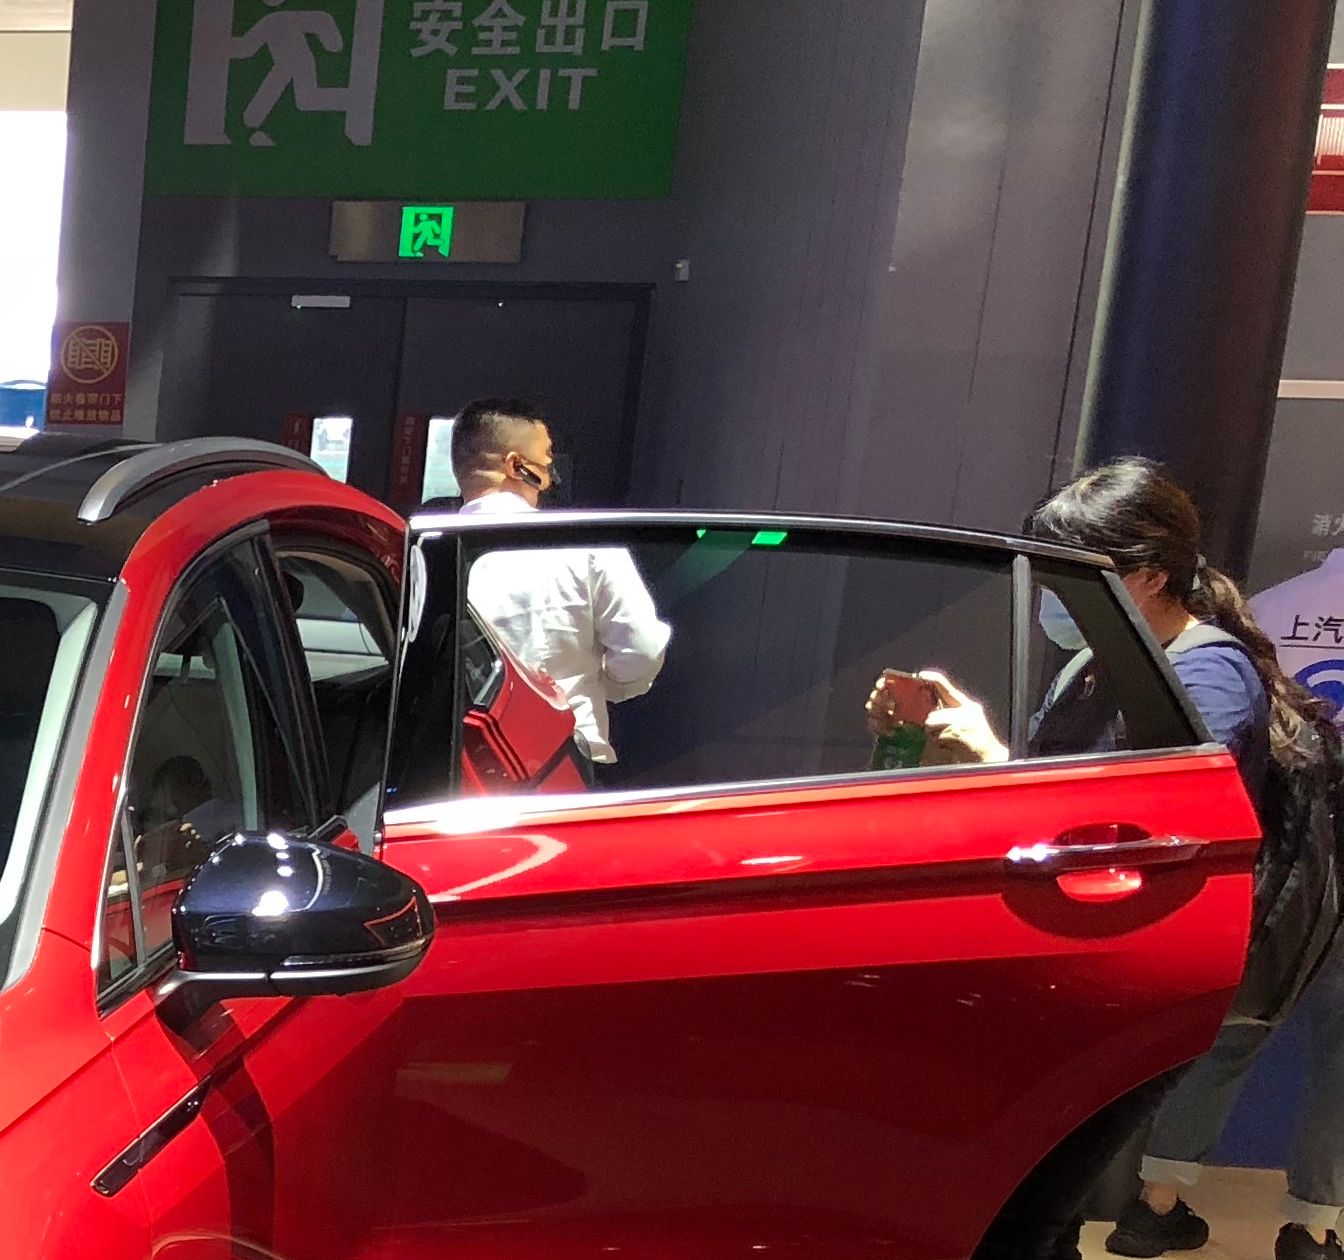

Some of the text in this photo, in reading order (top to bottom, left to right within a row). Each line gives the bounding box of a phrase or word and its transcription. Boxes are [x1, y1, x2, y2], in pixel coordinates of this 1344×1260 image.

[410, 0, 648, 57] 安全出口
[443, 68, 598, 110] EXIT
